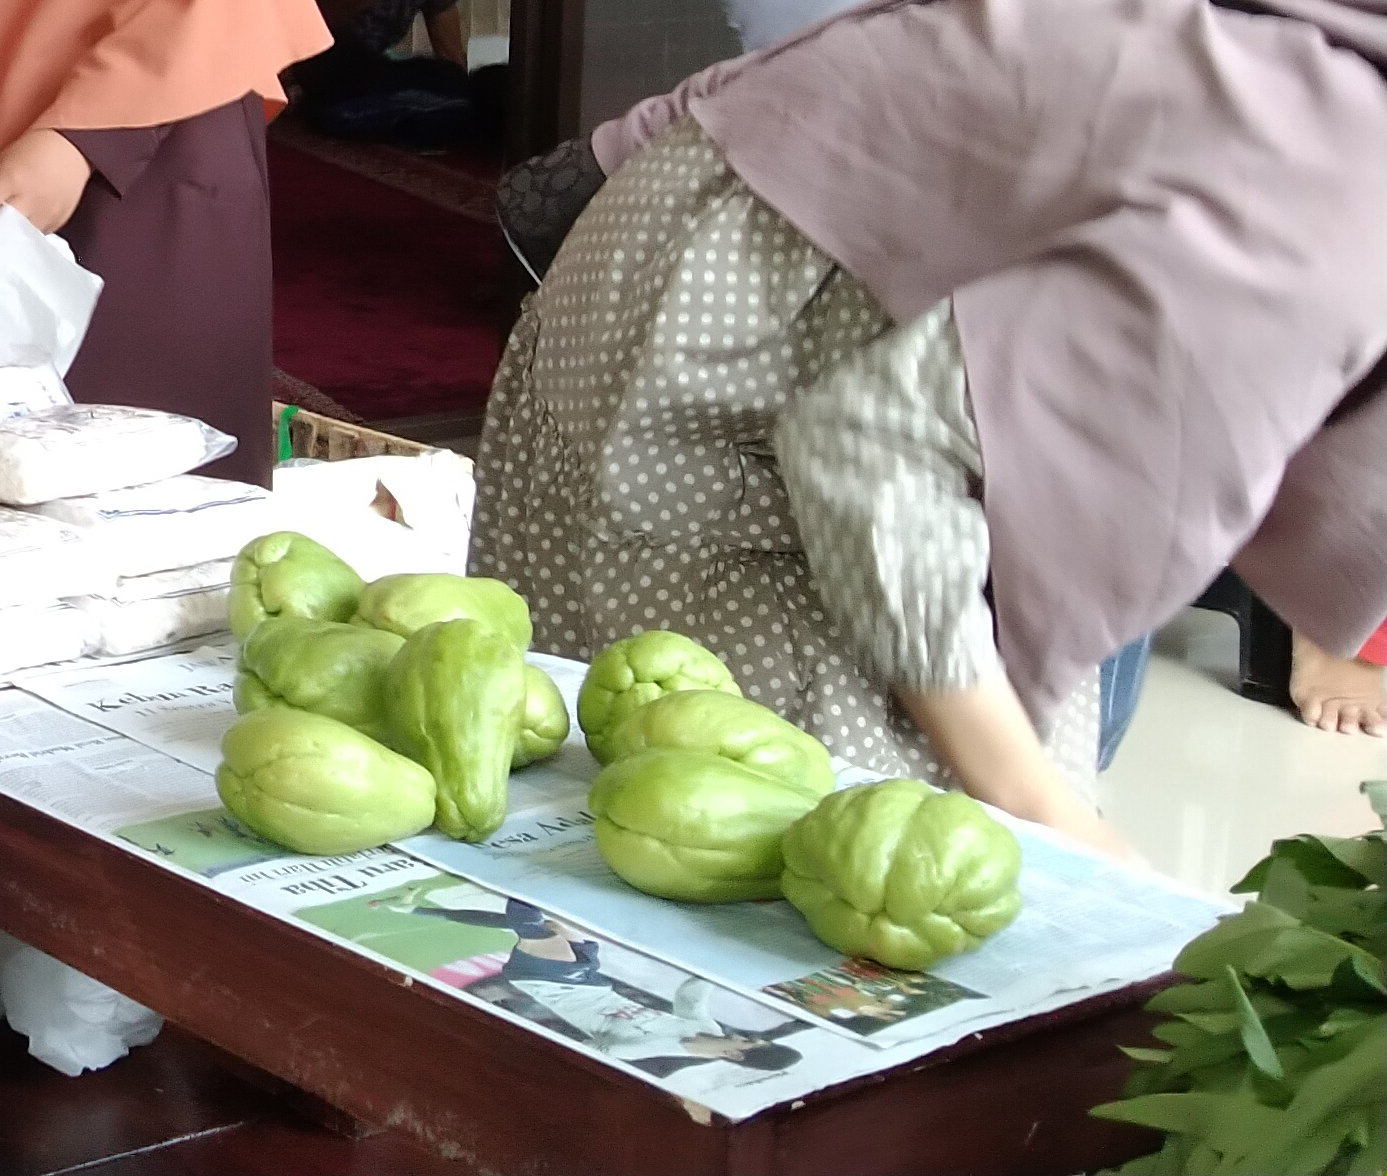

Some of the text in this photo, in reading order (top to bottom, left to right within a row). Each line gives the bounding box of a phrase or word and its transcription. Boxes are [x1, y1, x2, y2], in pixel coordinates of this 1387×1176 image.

[473, 832, 539, 850] esa
[280, 858, 416, 896] aru Tiba
